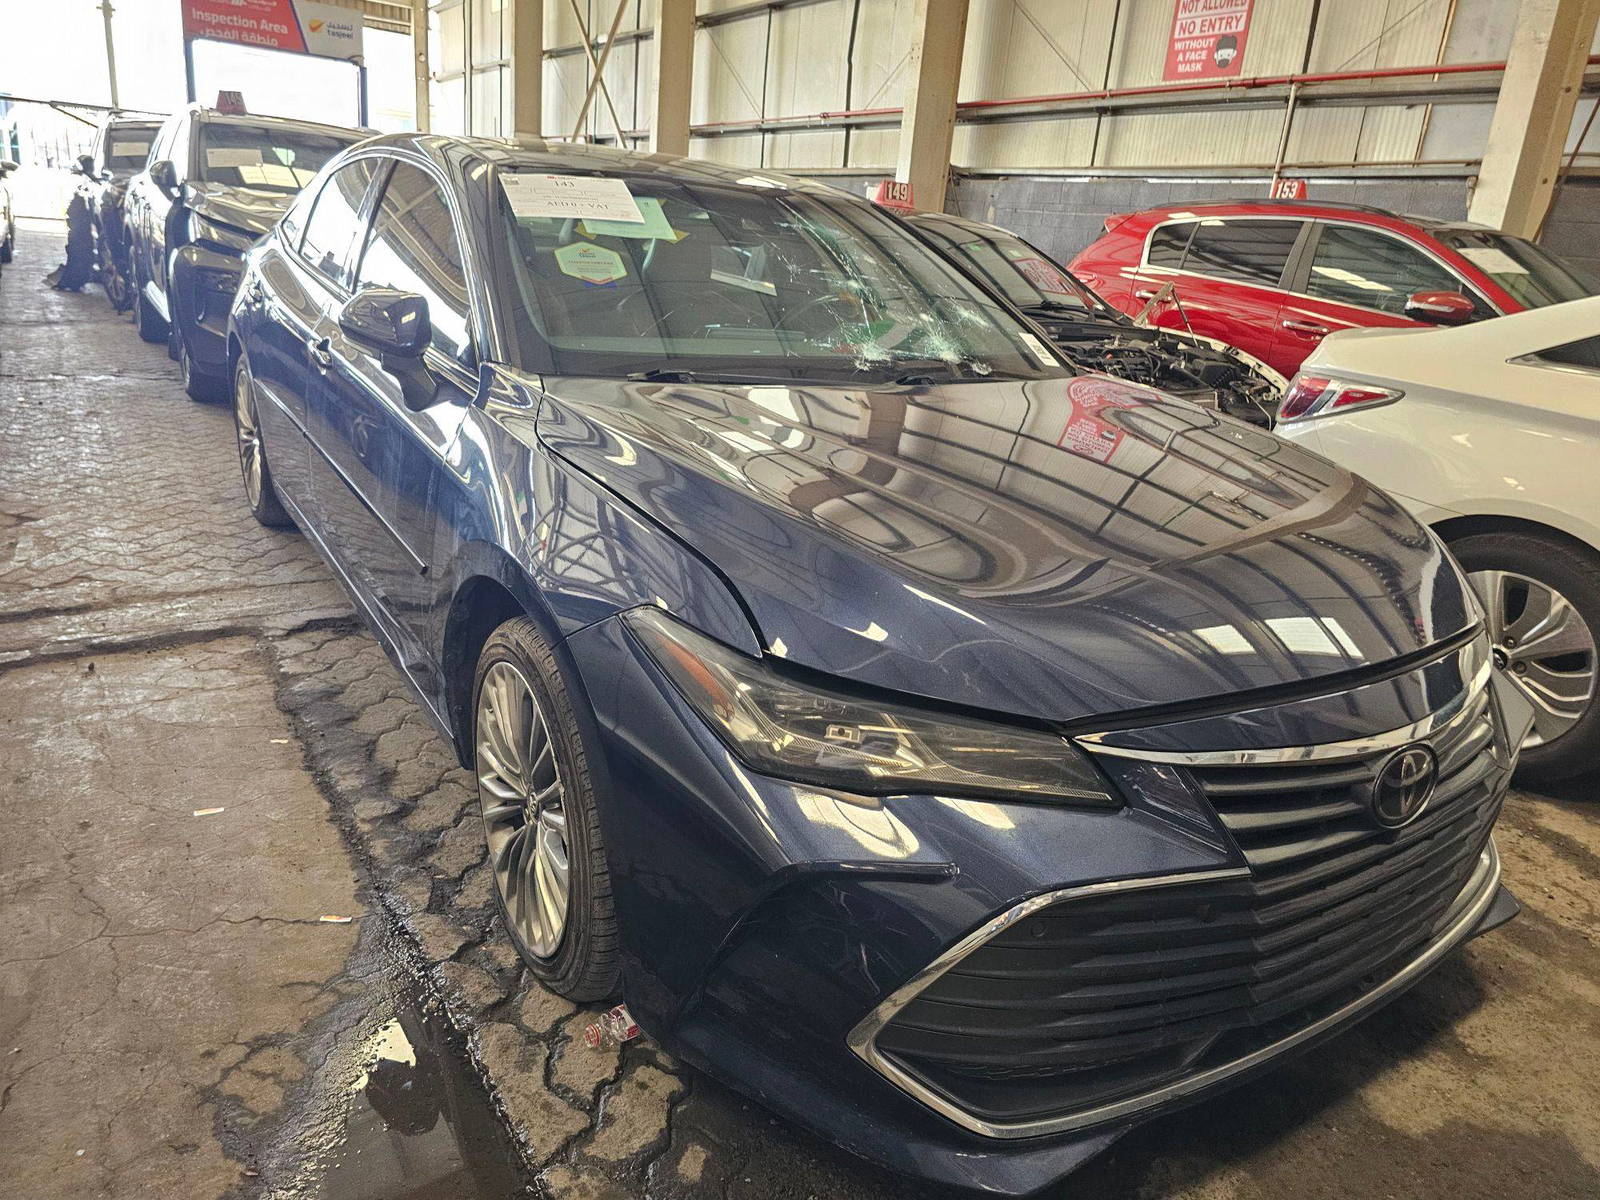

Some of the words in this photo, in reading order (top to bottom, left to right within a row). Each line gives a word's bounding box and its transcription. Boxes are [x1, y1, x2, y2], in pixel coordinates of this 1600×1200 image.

[1180, 0, 1199, 14] NOT
[192, 7, 258, 29] Inspection
[260, 19, 288, 34] Area
[1178, 20, 1196, 37] NO
[1200, 15, 1243, 33] ENTRY
[241, 30, 278, 47] منطقة
[1174, 38, 1215, 51] WITHOUT
[1177, 52, 1184, 62] A
[1185, 50, 1208, 61] FACE
[1177, 62, 1203, 73] MASK
[887, 182, 908, 201] 149
[1275, 181, 1299, 200] 153
